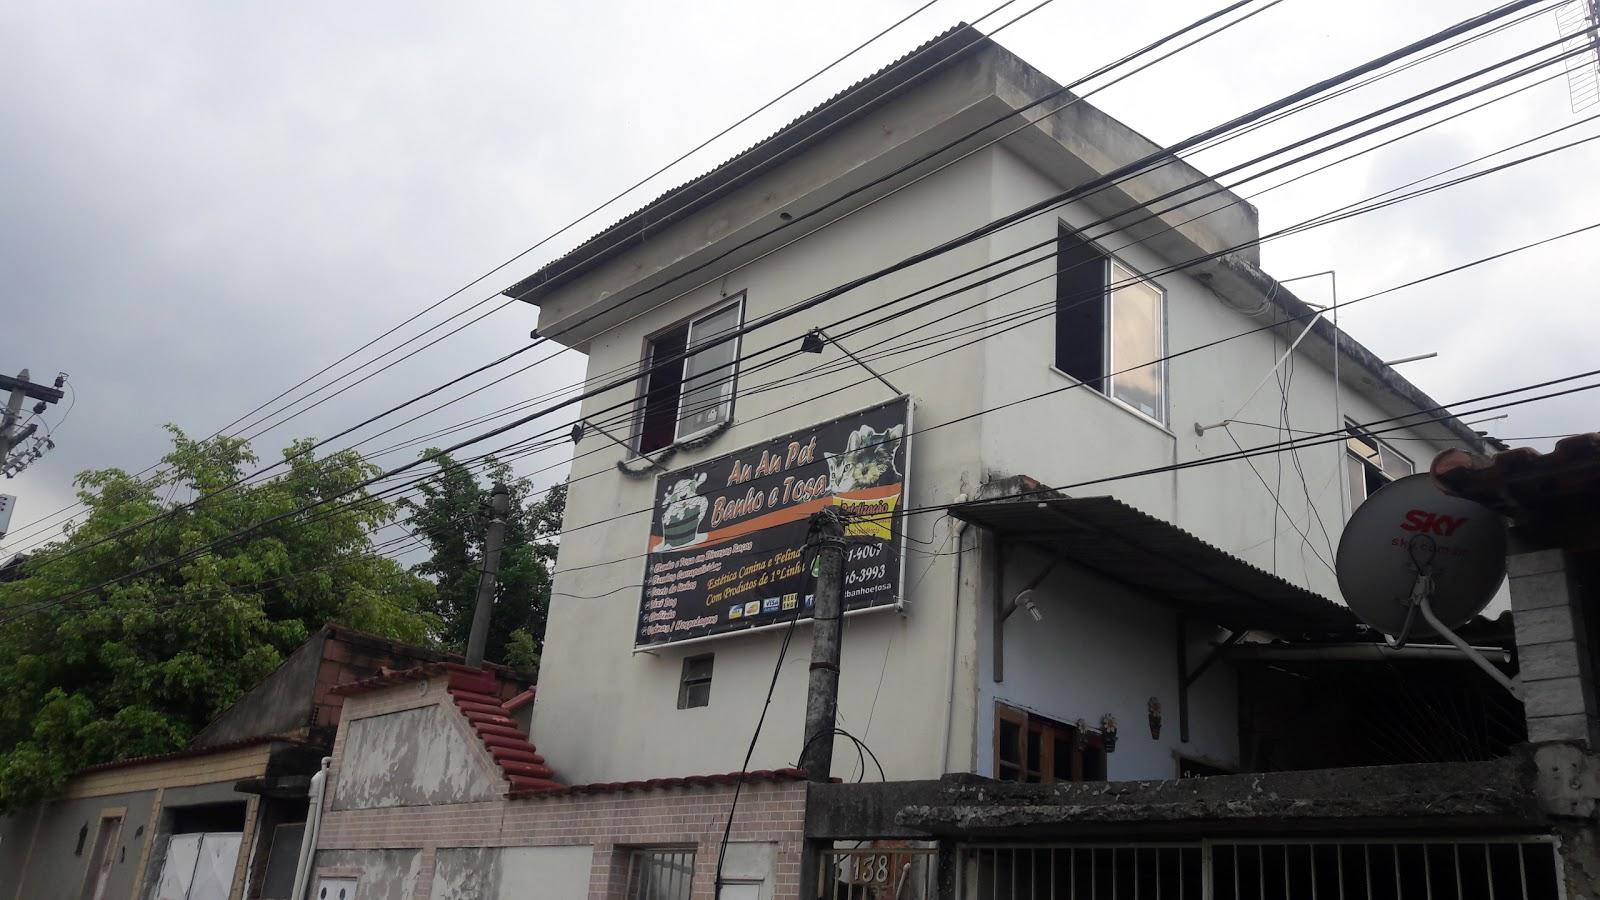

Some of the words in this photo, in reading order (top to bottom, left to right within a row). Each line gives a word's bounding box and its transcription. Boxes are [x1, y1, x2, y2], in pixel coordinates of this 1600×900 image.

[726, 459, 753, 486] Au
[755, 449, 783, 477] Au
[785, 436, 817, 469] Pet
[710, 486, 765, 528] Banho
[767, 486, 779, 507] e
[783, 474, 828, 505] Tosa
[1400, 509, 1471, 536] SKY
[707, 571, 737, 589] Estética
[739, 562, 766, 579] Canina
[768, 560, 774, 568] e
[774, 549, 801, 564] Felina
[706, 590, 723, 606] Com
[723, 580, 757, 598] Produtos
[759, 576, 768, 589] de
[853, 854, 889, 883] 138
